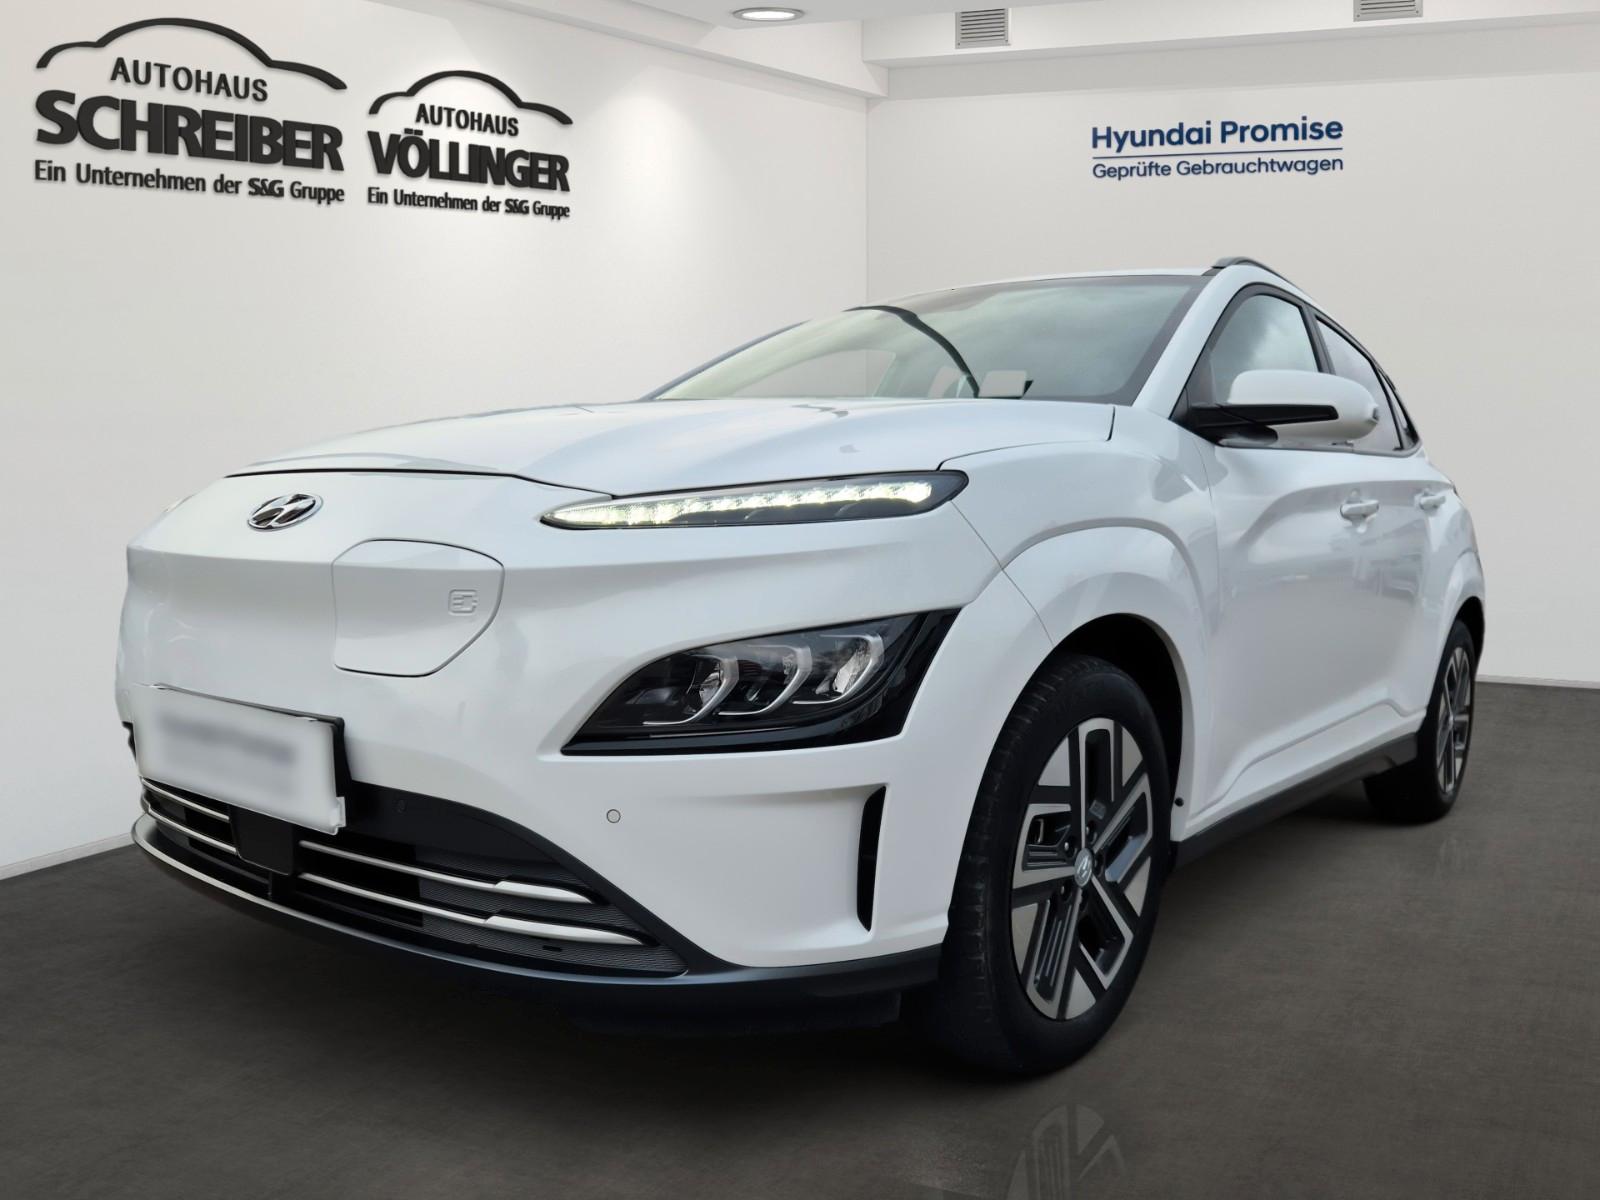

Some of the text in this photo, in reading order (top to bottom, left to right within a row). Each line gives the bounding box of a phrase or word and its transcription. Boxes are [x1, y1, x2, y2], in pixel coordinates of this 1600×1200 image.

[110, 56, 268, 103] AUTOHAUS
[35, 89, 345, 172] SCHREIBER
[415, 103, 519, 137] AUTOHAUS
[1091, 115, 1344, 153] Hyundai Promise
[367, 127, 571, 193] VÖLLINGER
[1092, 157, 1344, 181] Geprüfte Gebrauchtwagen
[34, 159, 345, 206] Ein Unternehmen der S&G Gruppe
[367, 186, 571, 221] Ein Unternehmen der S&G Gruppe
